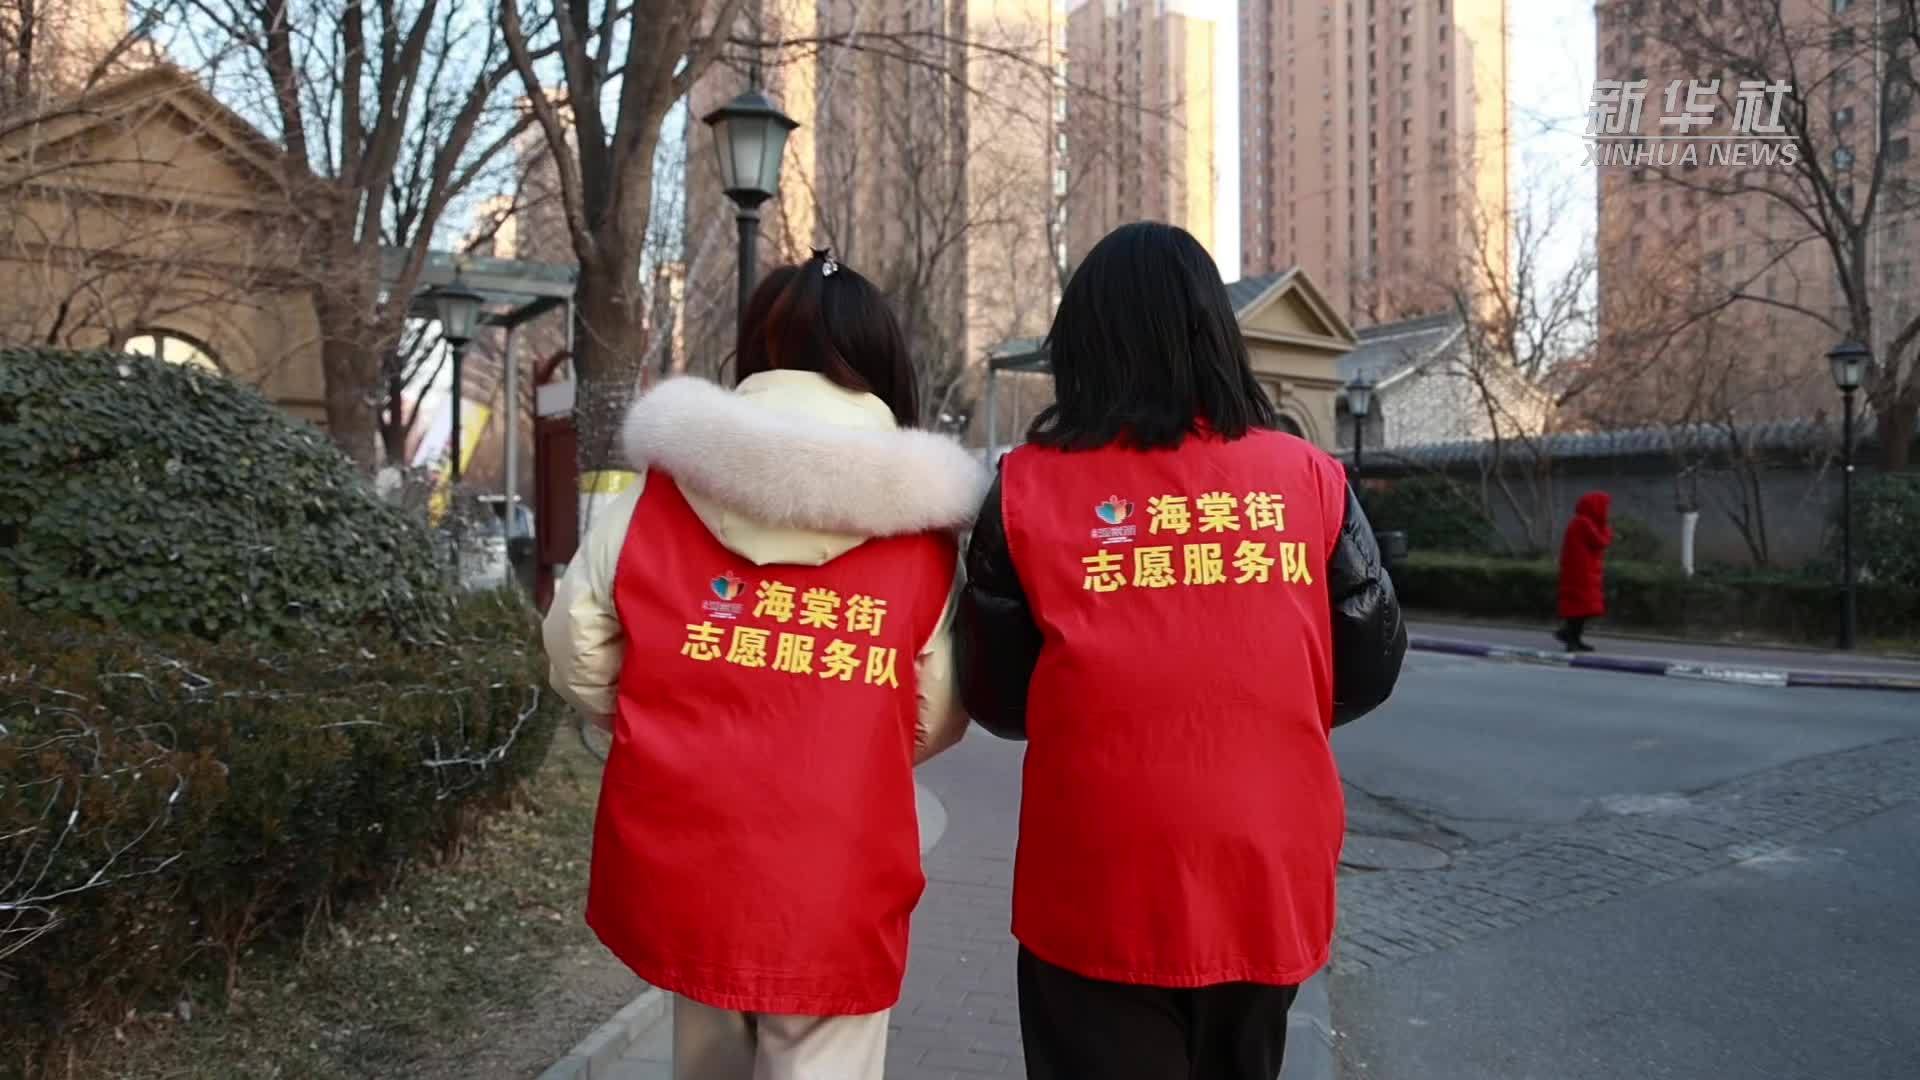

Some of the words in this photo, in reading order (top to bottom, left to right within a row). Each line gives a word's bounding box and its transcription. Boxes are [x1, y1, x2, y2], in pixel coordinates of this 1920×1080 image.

[1145, 491, 1286, 536] 海棠街
[1081, 540, 1313, 593] 志愿服务队
[752, 579, 888, 637] 海棠街
[680, 620, 900, 689] 志愿服务队
